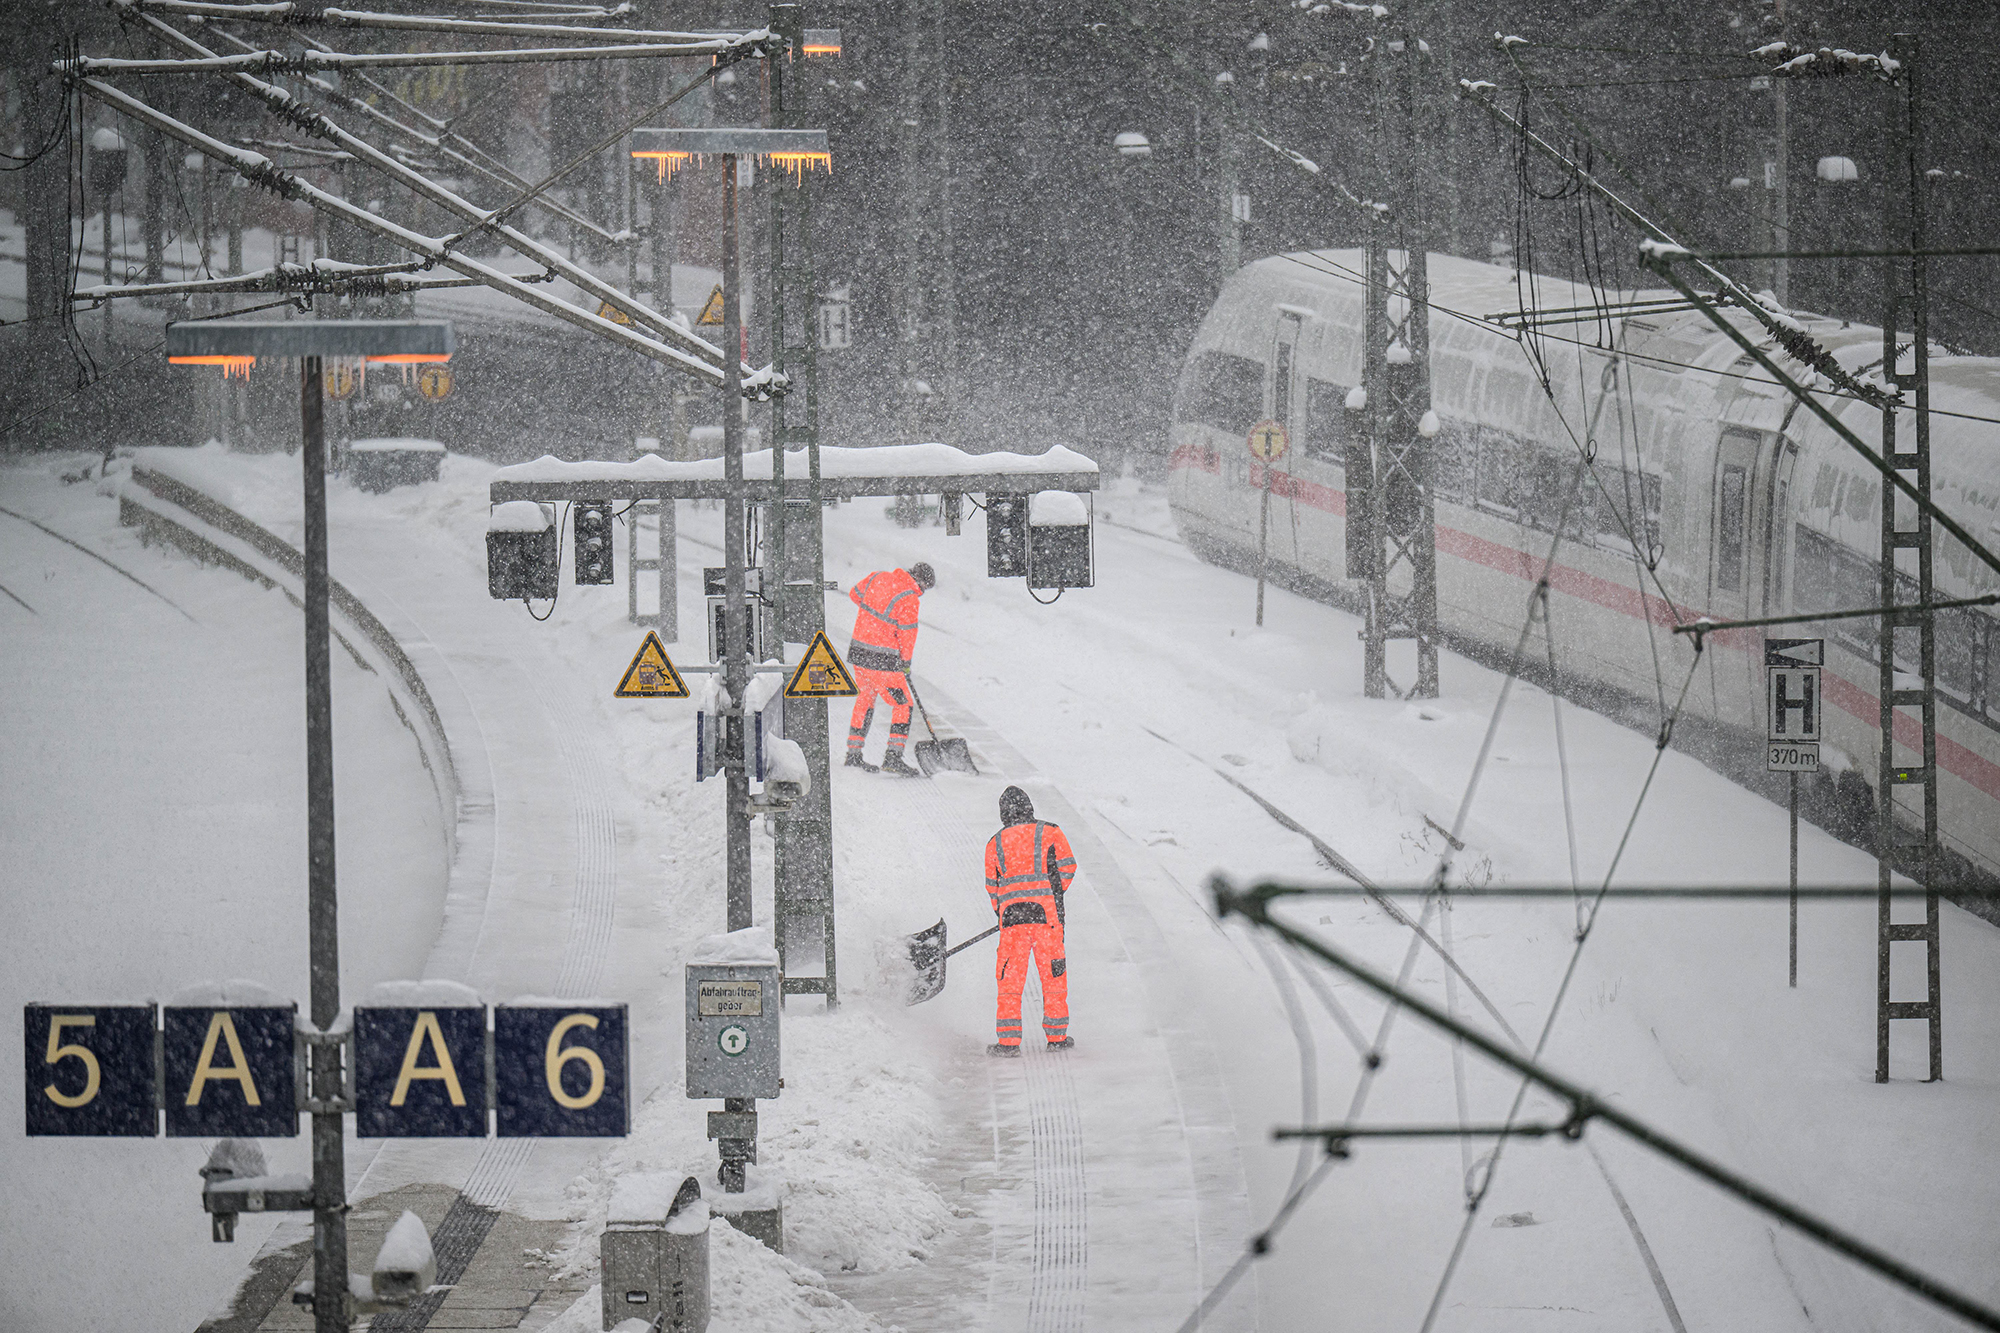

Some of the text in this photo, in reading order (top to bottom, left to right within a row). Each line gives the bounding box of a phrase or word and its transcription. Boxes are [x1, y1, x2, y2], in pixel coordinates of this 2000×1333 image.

[1776, 674, 1813, 733] H
[1770, 748, 1815, 765] 370 m
[44, 1012, 261, 1108] 5 A
[389, 1012, 606, 1109] A 6
